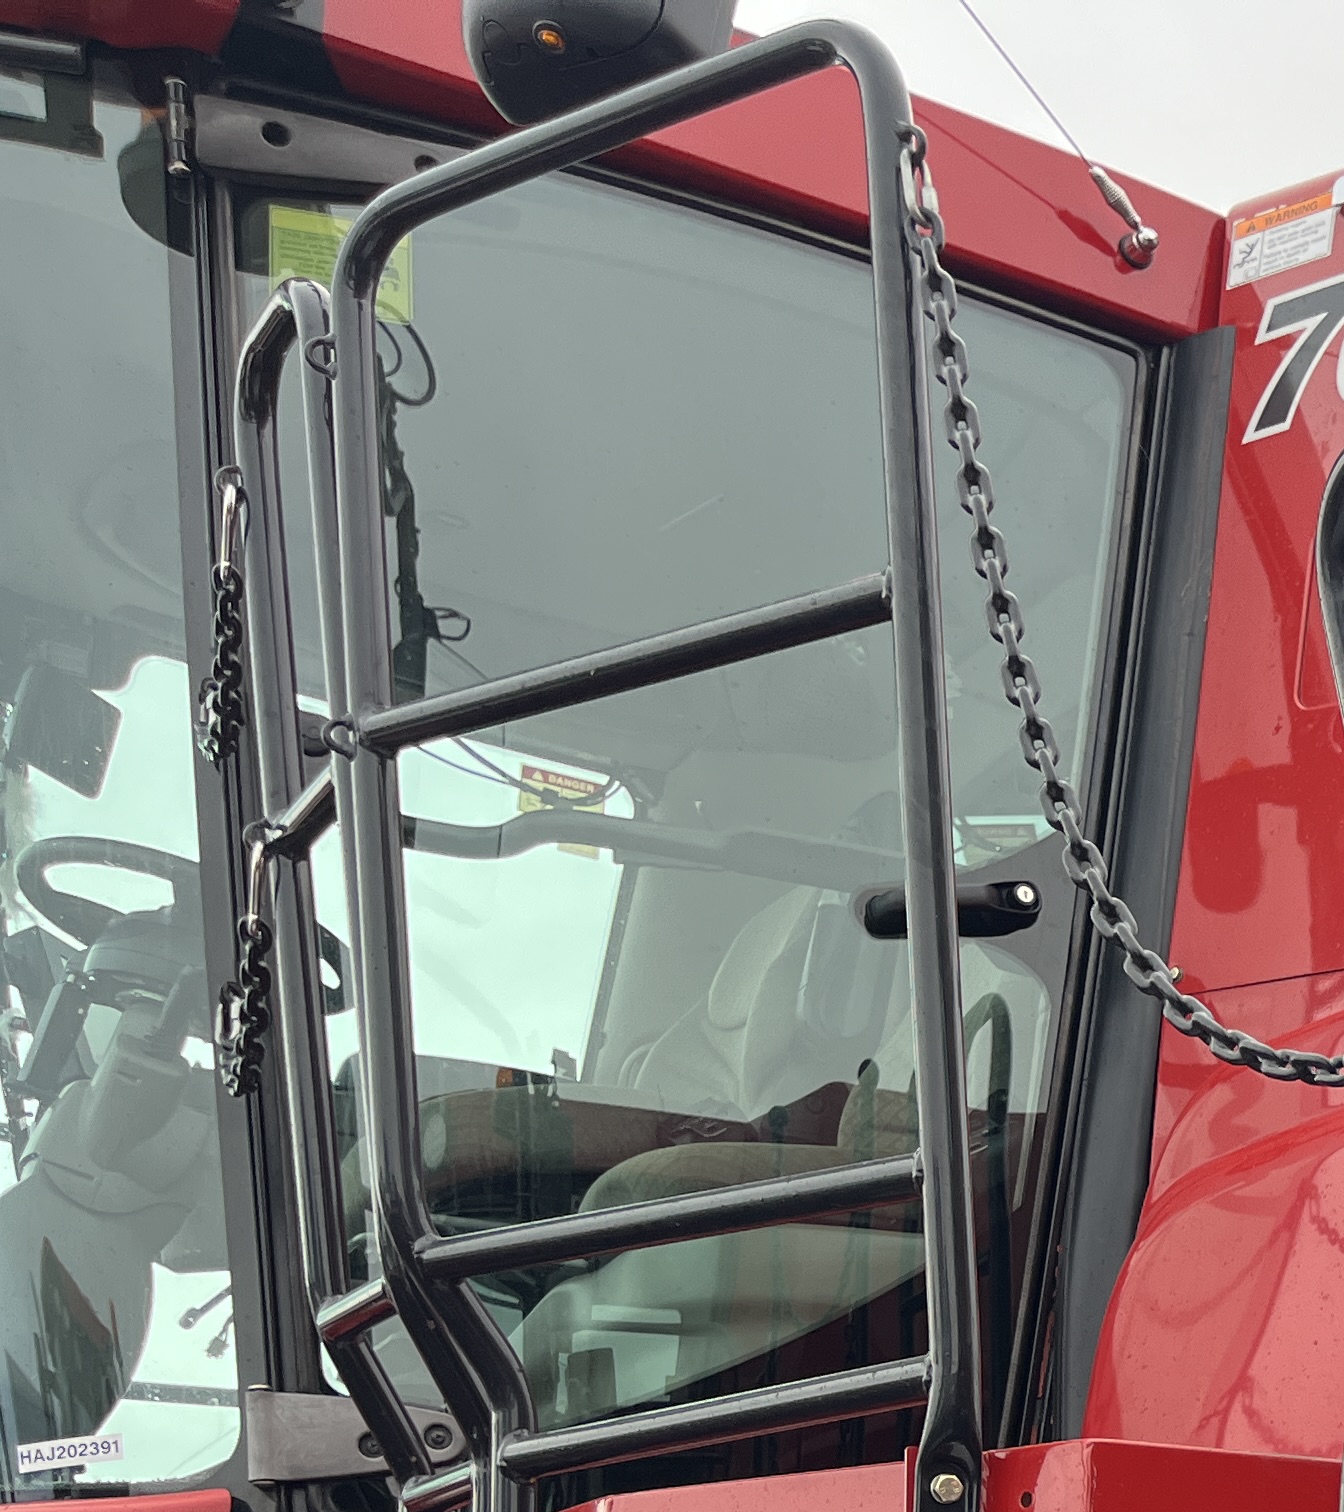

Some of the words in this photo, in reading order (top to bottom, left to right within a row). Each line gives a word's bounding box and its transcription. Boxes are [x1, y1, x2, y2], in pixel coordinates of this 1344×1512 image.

[1264, 201, 1319, 227] WARNING
[549, 775, 596, 793] DANGER
[20, 1440, 119, 1465] HAJ202391
